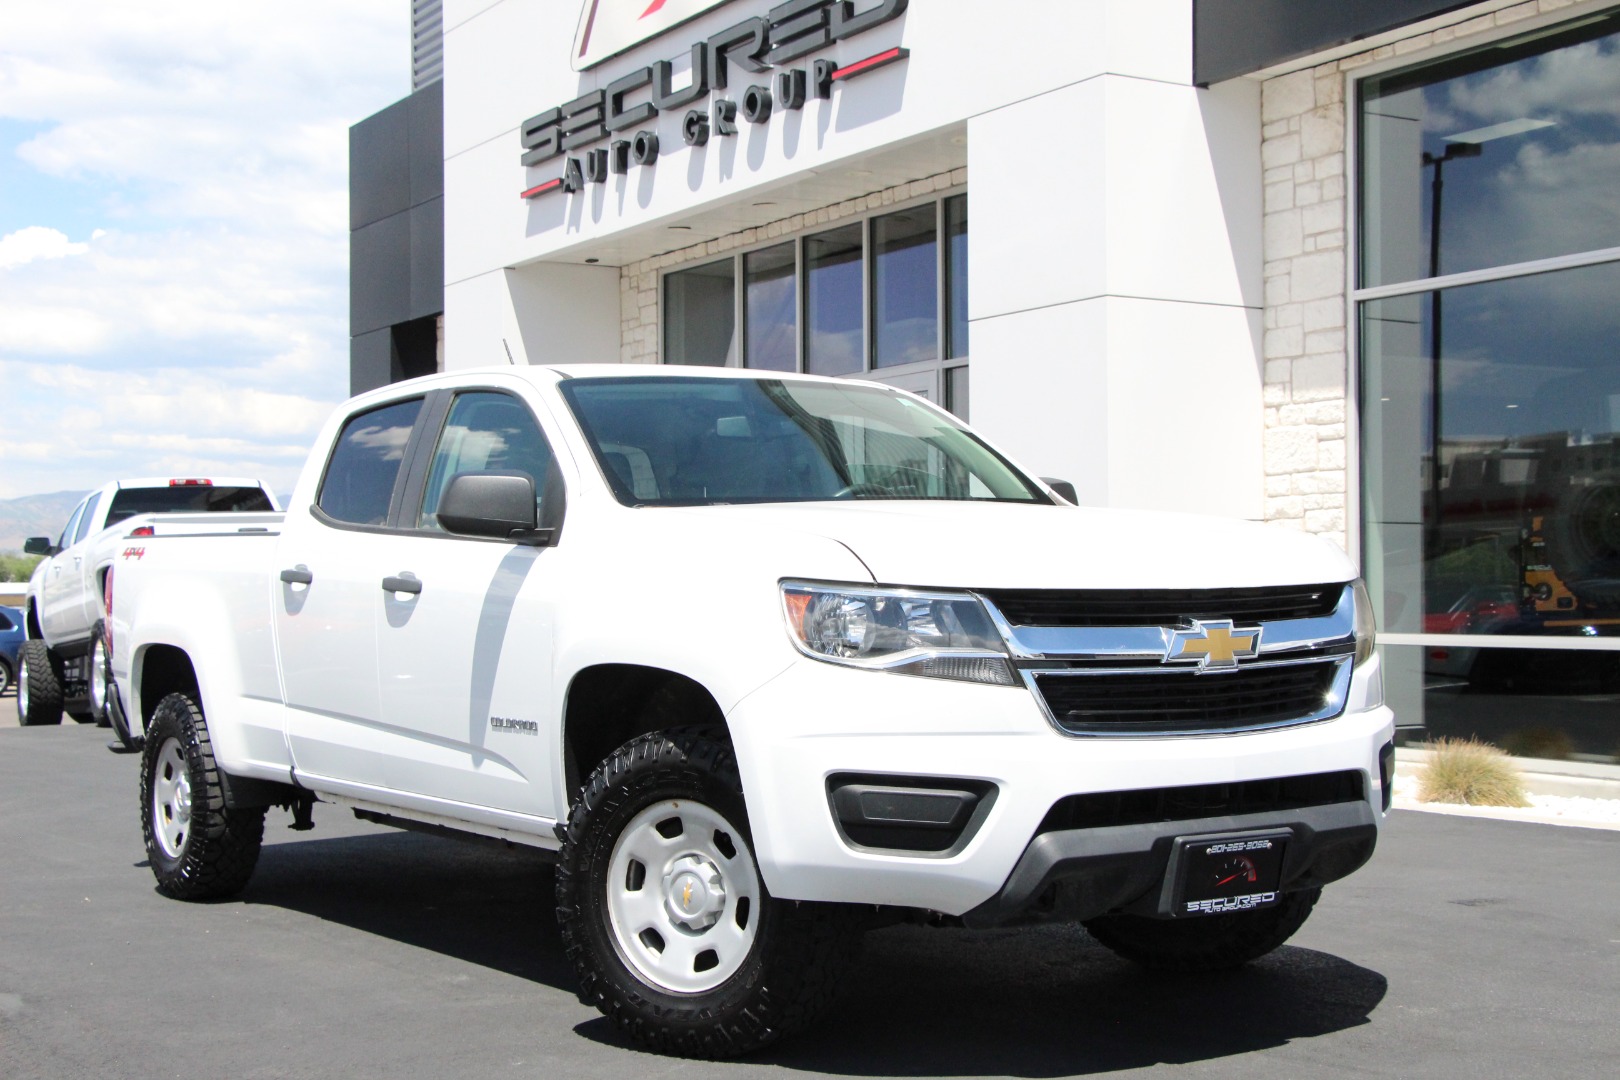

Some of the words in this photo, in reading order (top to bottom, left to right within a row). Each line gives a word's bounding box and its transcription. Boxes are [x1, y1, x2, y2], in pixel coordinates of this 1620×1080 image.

[562, 130, 659, 194] AUTO
[682, 58, 839, 147] GROUP
[1187, 892, 1276, 912] SECURED
